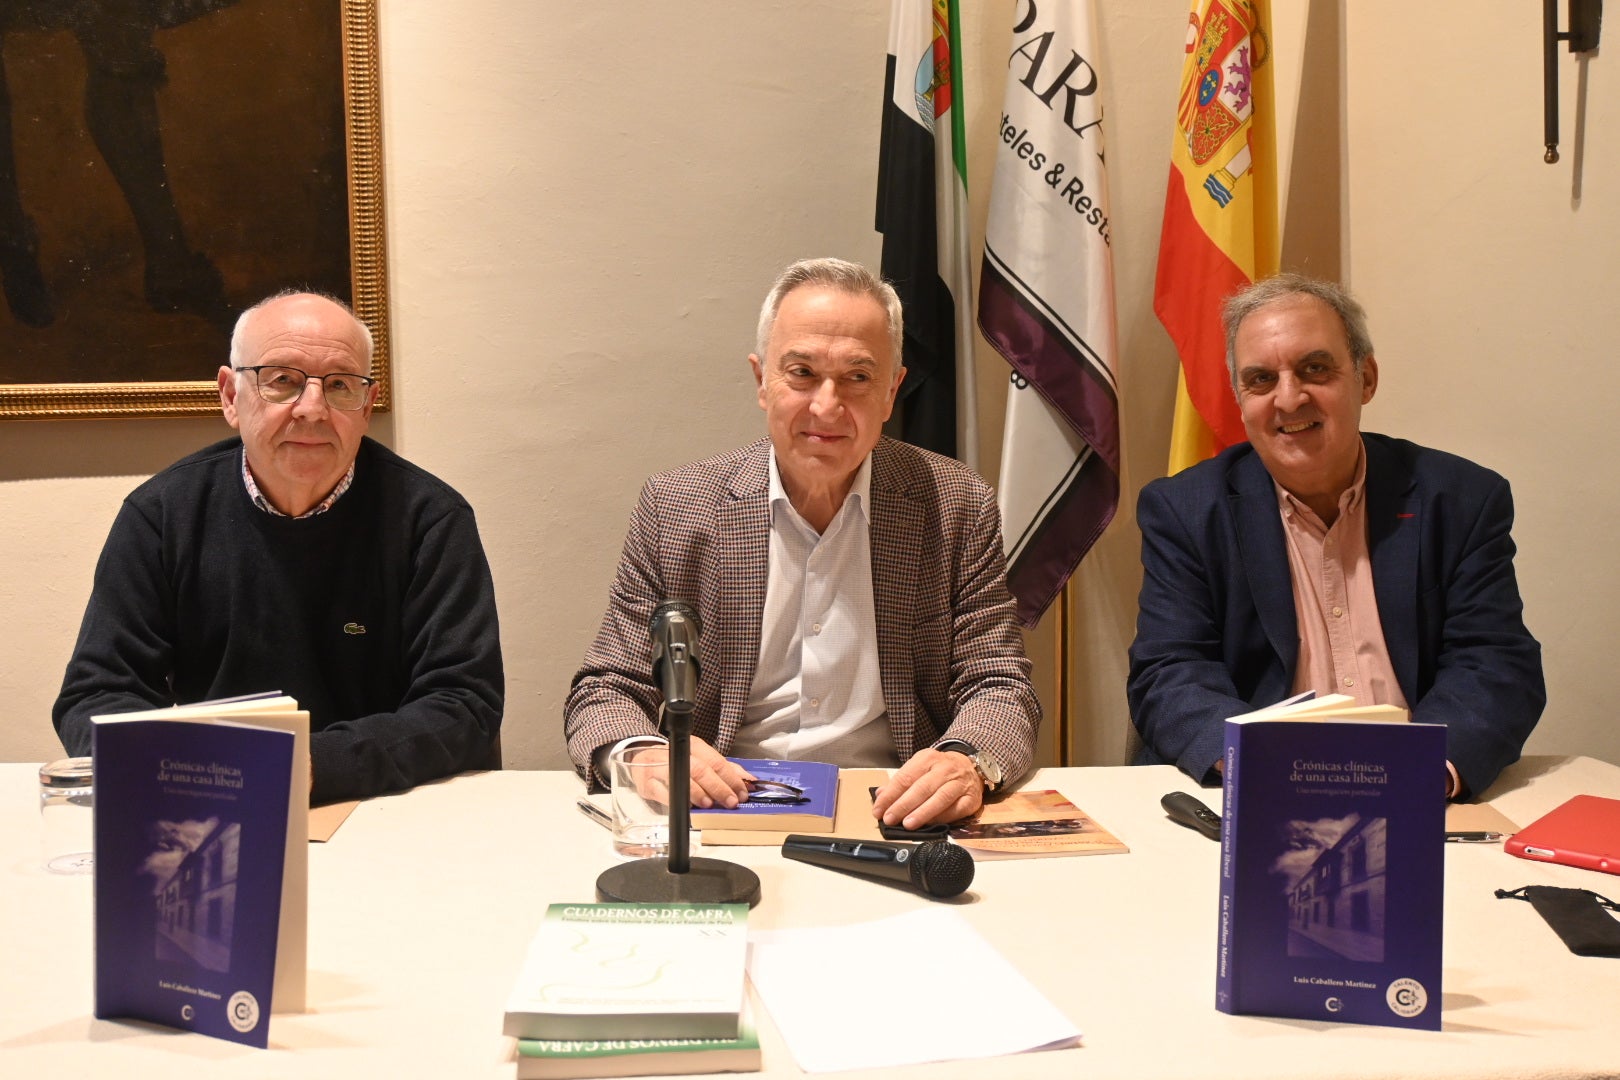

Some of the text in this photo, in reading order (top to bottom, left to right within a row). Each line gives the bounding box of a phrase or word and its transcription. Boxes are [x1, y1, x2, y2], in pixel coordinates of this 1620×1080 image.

[1000, 112, 1046, 171] teles
[1044, 163, 1065, 189] &
[207, 762, 242, 777] clínicas
[1293, 759, 1385, 773] Crónicas clínicas
[157, 770, 243, 789] de una casa liberal
[1289, 770, 1388, 785] de una casa liberal
[1225, 810, 1234, 819] de
[1223, 854, 1232, 878] liberal
[563, 906, 659, 919] CUADERNOS
[661, 908, 682, 919] DE
[1221, 912, 1229, 945] Caballero
[1293, 976, 1310, 984] Luis
[1310, 976, 1344, 987] Caballero
